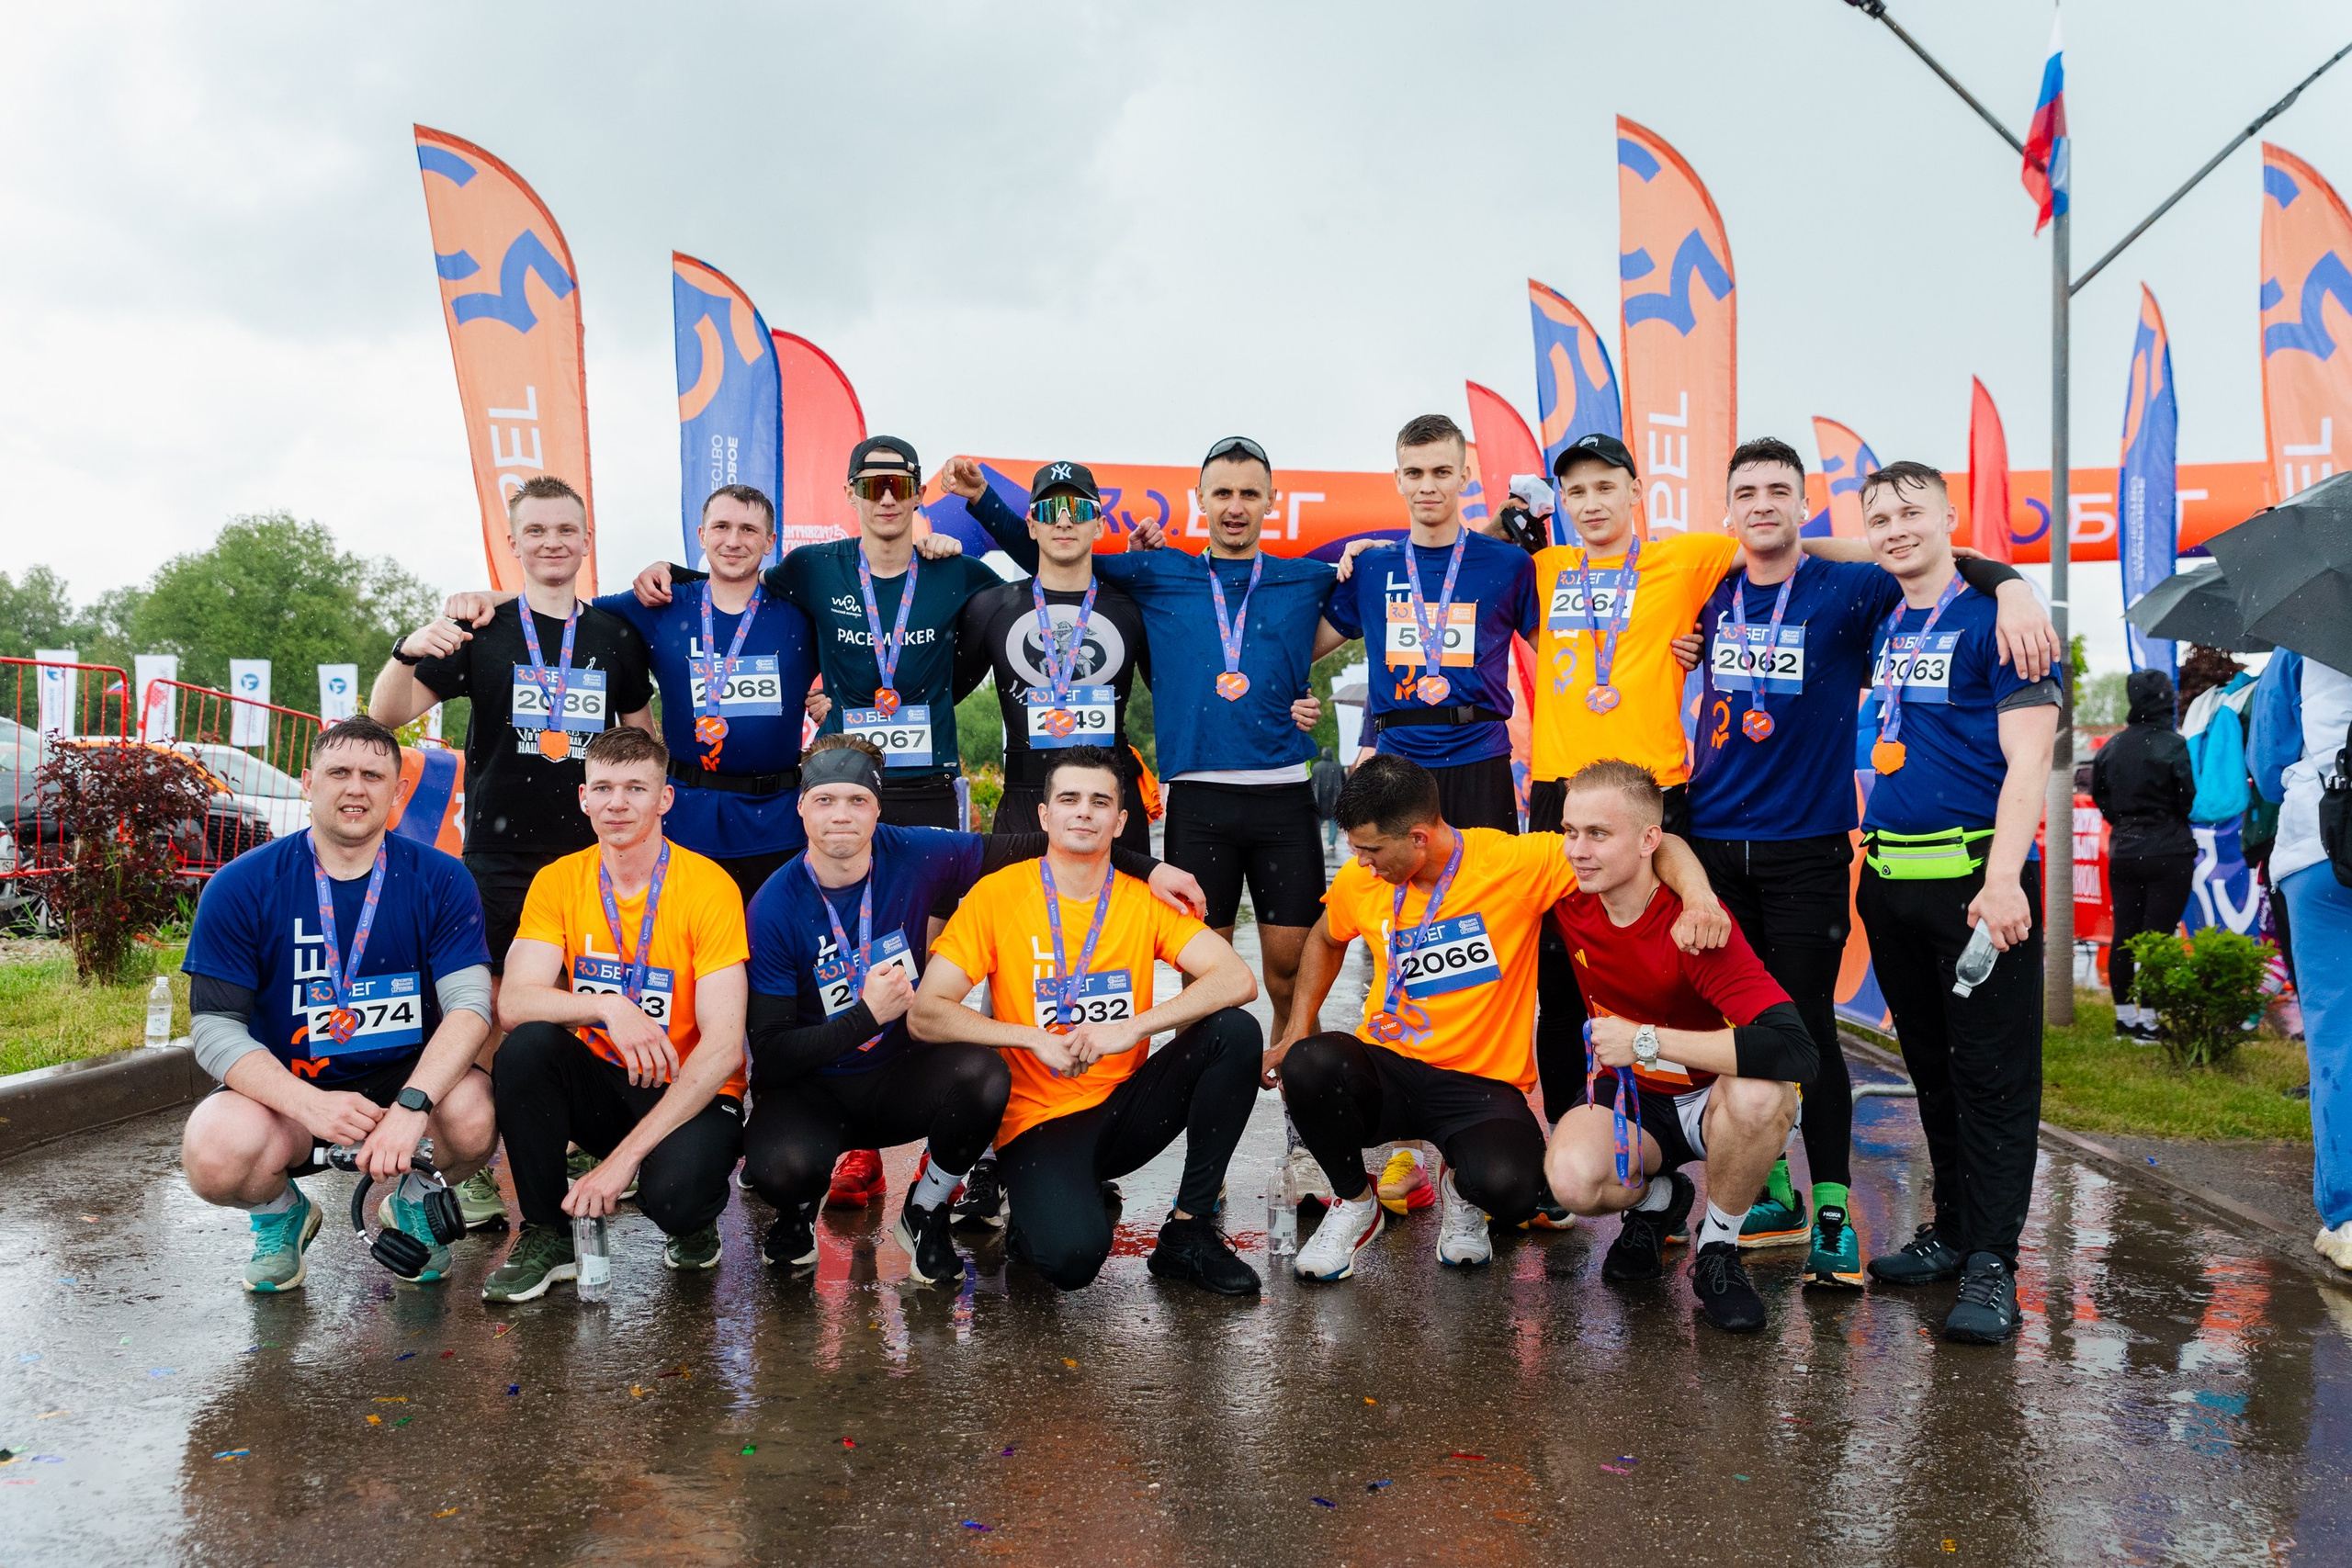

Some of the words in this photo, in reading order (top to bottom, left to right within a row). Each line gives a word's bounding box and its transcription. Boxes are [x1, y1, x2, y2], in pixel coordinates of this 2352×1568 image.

[1050, 463, 1072, 480] NY
[837, 627, 935, 647] PACEMKER
[1718, 649, 1797, 674] 2062
[1881, 659, 1945, 682] 2063
[695, 679, 777, 702] 2068
[517, 690, 601, 715] 2036
[1036, 709, 1106, 730] 249
[1401, 942, 1489, 980] 2066
[1043, 998, 1129, 1029] 2032
